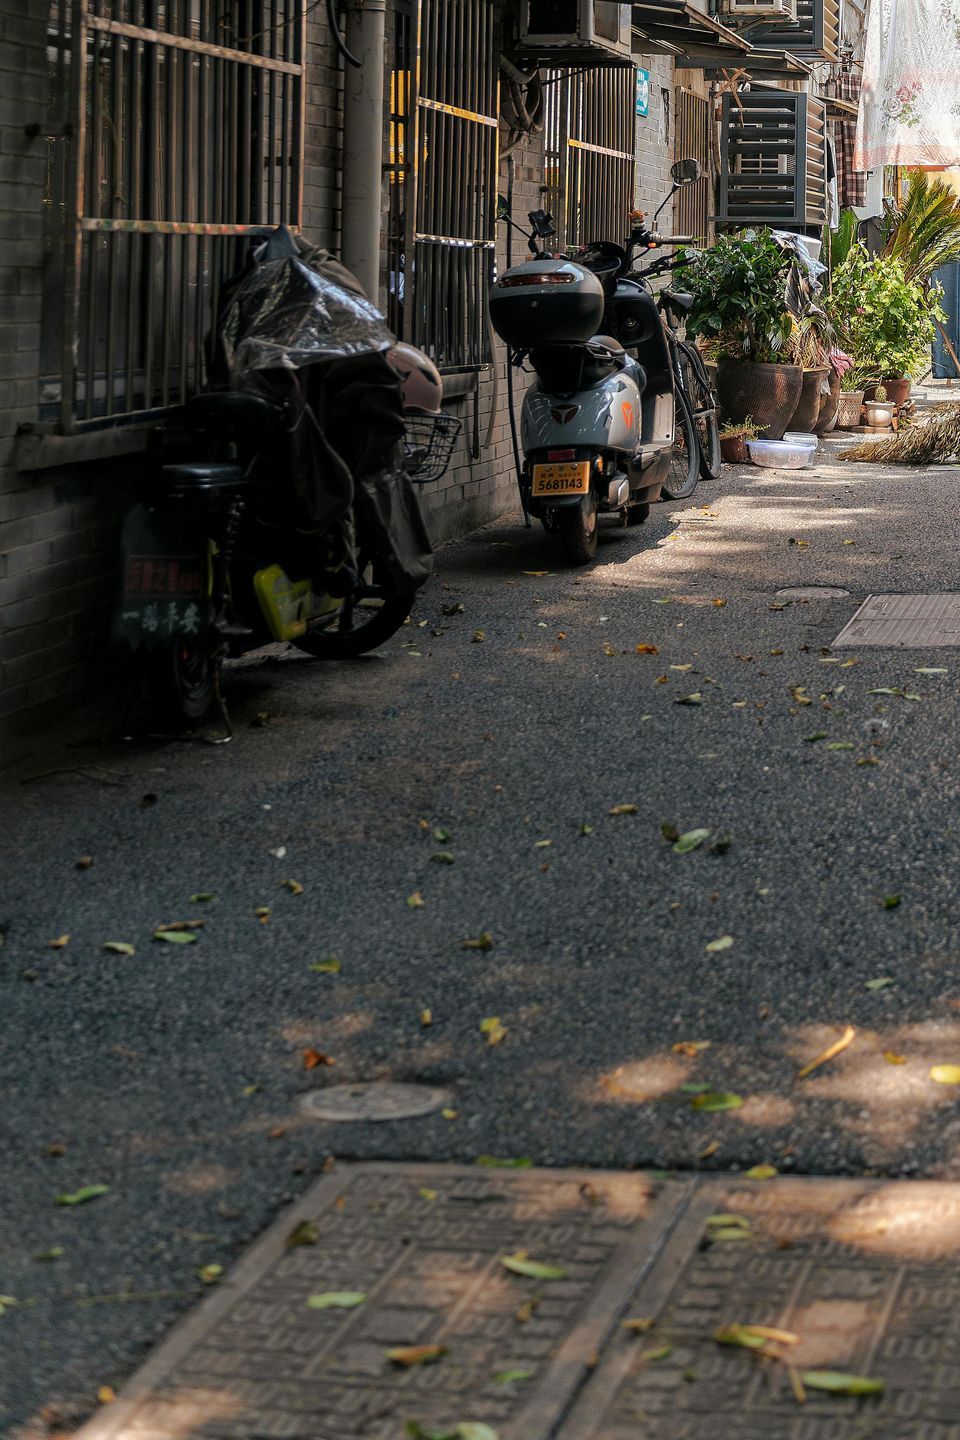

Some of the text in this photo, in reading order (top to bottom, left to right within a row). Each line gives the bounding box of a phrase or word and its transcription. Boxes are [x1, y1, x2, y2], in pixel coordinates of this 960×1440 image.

[538, 478, 583, 491] 5681143
[122, 601, 201, 635] 一路平安
